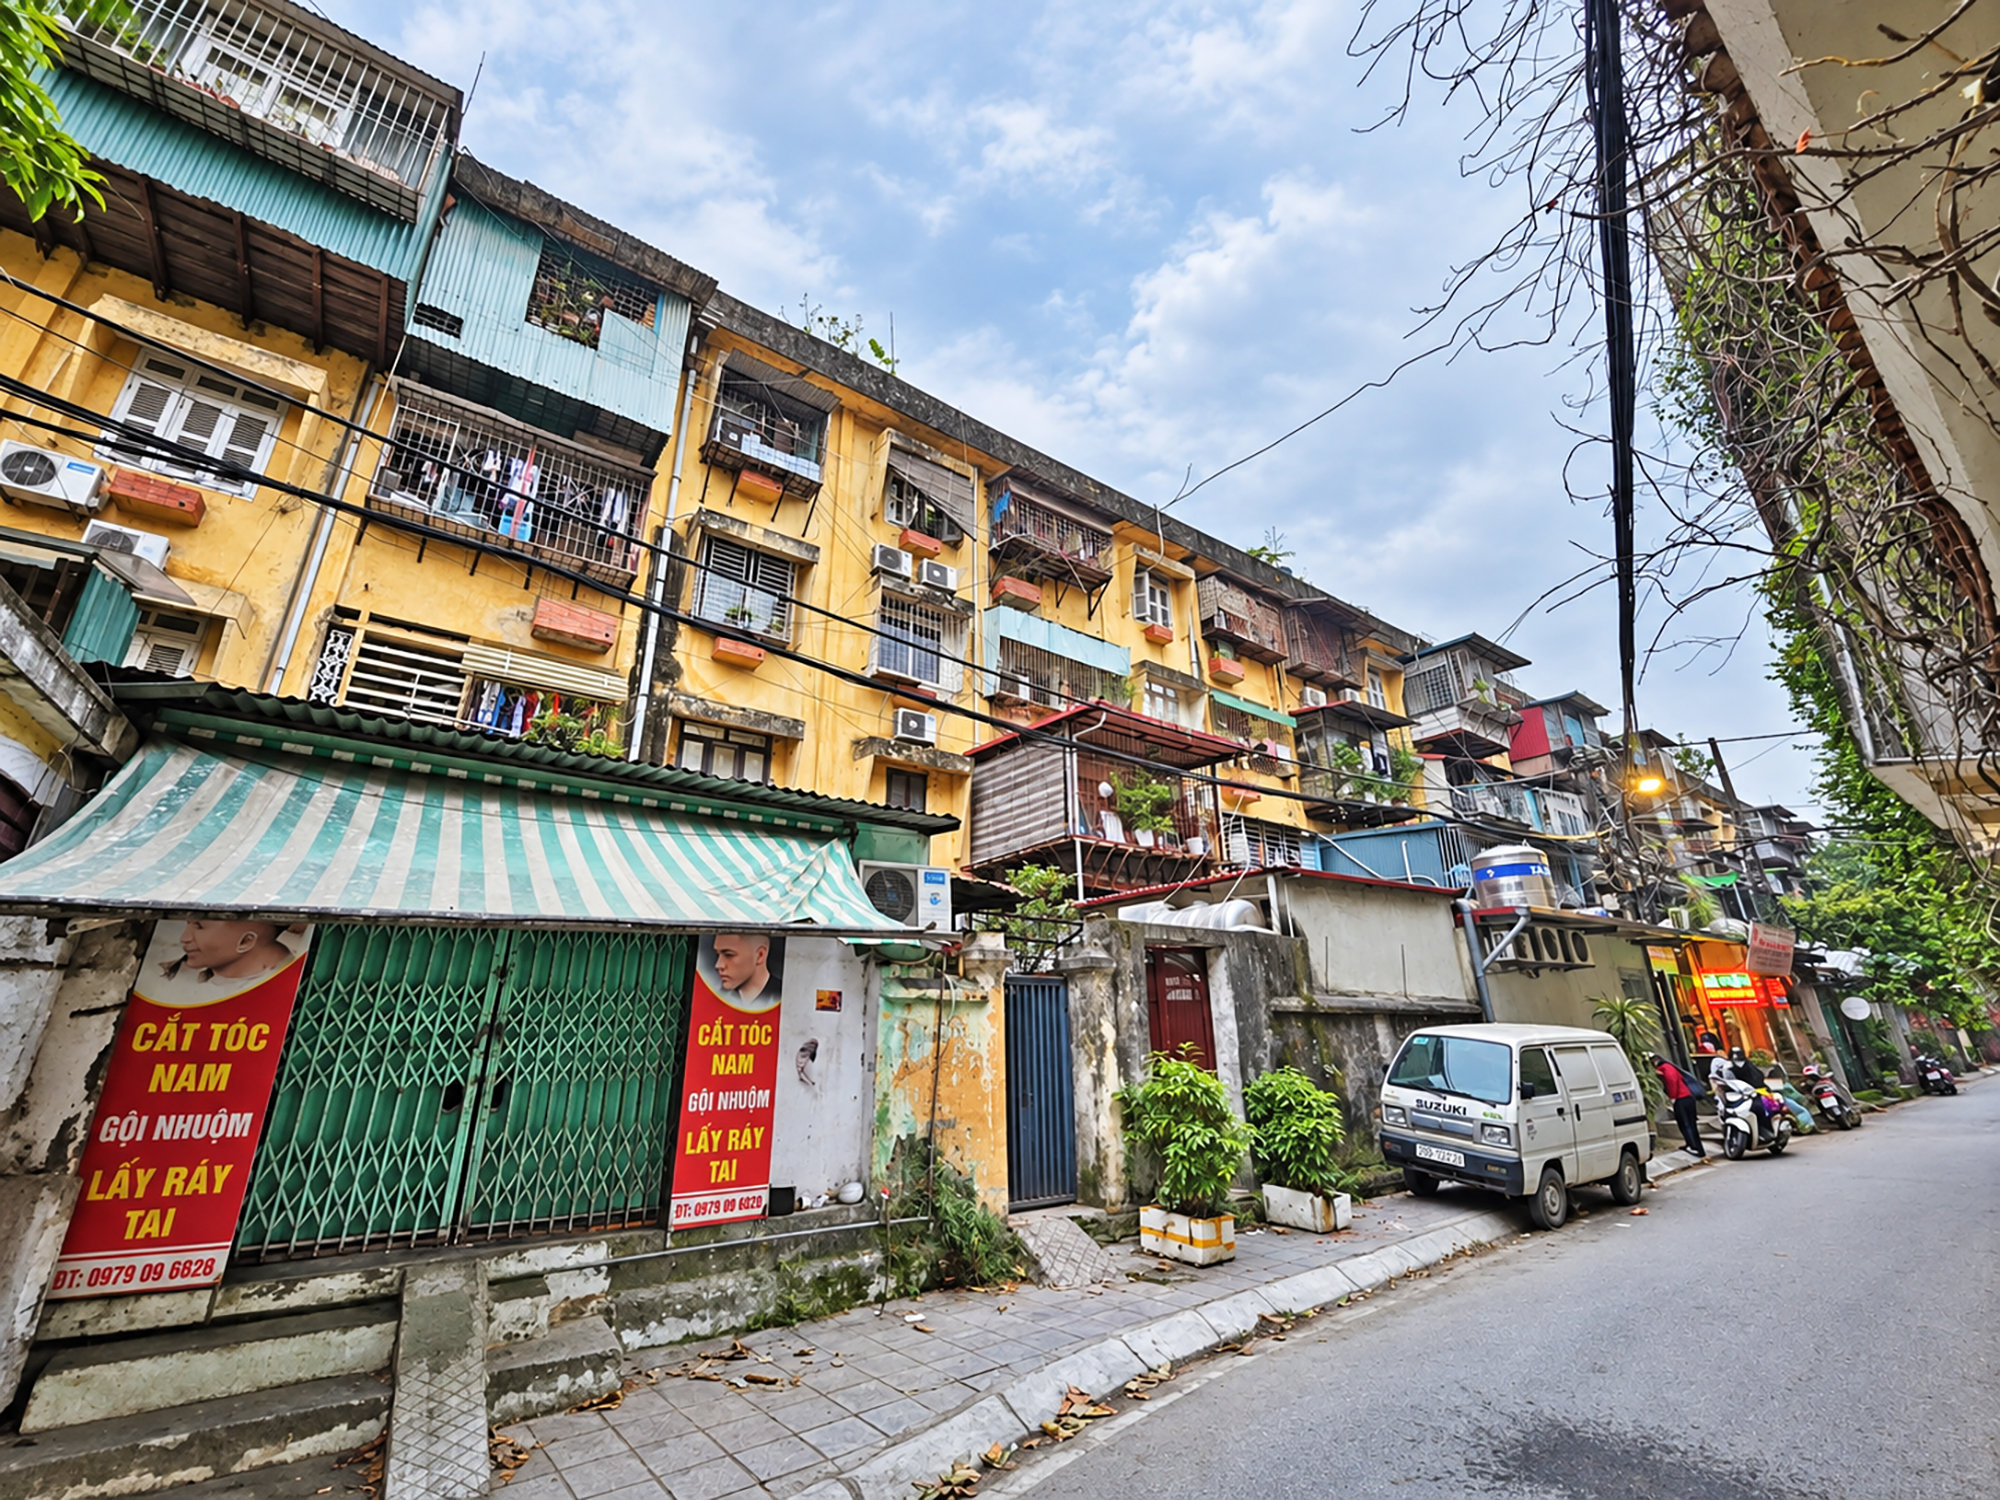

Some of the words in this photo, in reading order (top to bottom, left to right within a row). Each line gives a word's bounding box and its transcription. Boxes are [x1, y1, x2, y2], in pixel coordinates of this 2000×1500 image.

[131, 1012, 201, 1052] CẮT
[208, 1017, 270, 1052] TÓC
[698, 1016, 734, 1046] CẮT
[739, 1020, 773, 1046] TÓC
[147, 1063, 232, 1093] NAM
[711, 1053, 755, 1076] NAM
[688, 1088, 714, 1116] GỘI
[717, 1085, 771, 1114] NHUỘM
[1415, 1099, 1467, 1116] SUZUKI
[99, 1110, 149, 1148] GỘI
[152, 1108, 254, 1145] NHUỘM
[685, 1122, 723, 1155] LẤY
[727, 1122, 765, 1151] RÁY
[86, 1157, 157, 1201] LẤY
[161, 1158, 234, 1197] RÁY
[709, 1158, 737, 1184] TAI
[124, 1207, 177, 1240] TAI
[52, 1269, 84, 1290] ĐT:
[87, 1265, 137, 1287] 0979
[139, 1262, 165, 1282] 09
[168, 1257, 216, 1280] 6828
